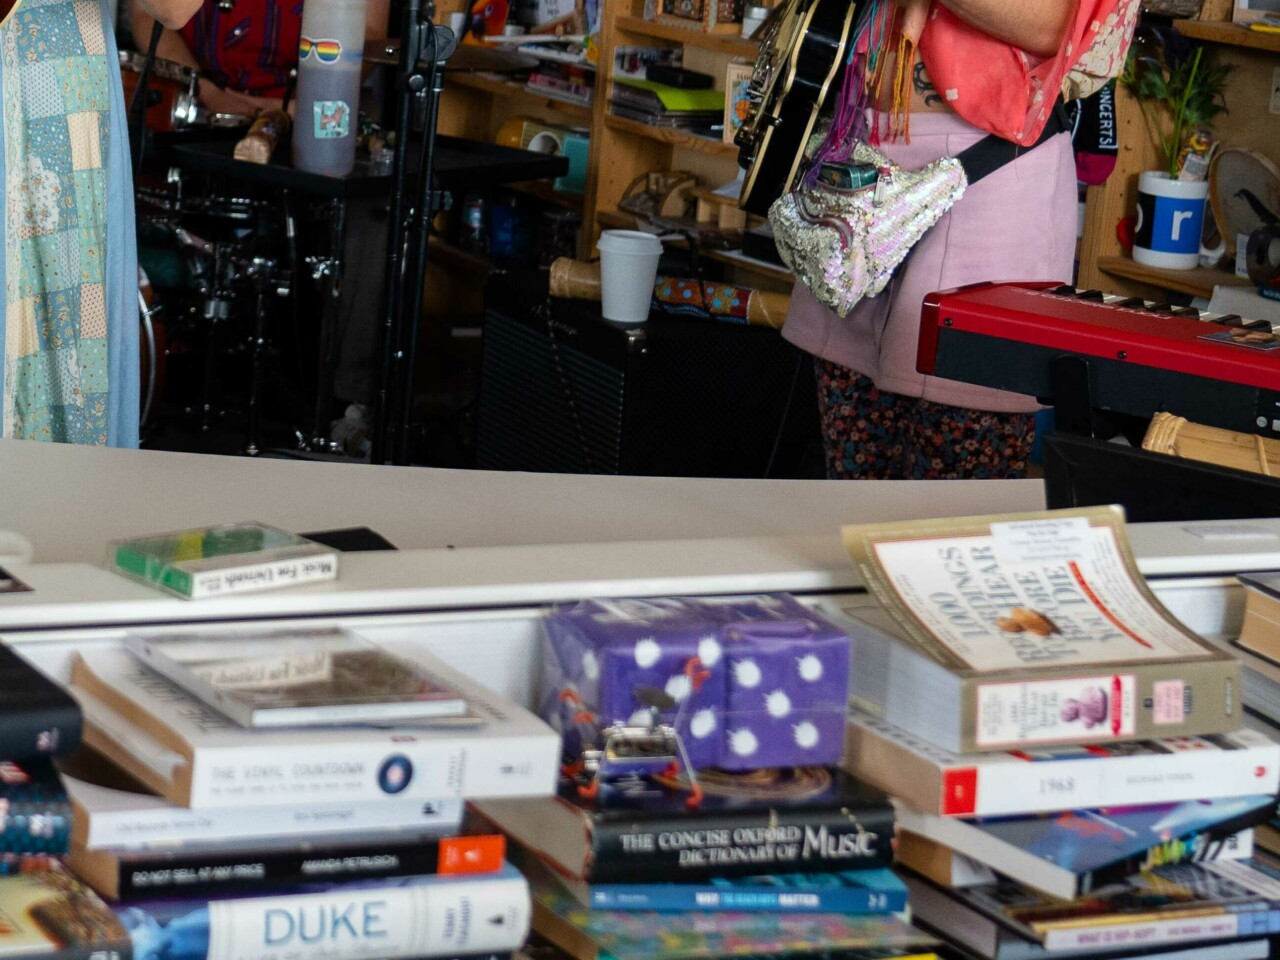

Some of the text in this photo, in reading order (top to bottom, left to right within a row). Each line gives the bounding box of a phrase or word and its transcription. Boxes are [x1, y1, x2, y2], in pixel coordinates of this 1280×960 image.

[969, 545, 1024, 609] HEAR
[1042, 565, 1087, 606] DIE
[210, 766, 236, 781] THE
[292, 761, 366, 778] COUNTDOWN
[1039, 777, 1075, 794] 1968
[621, 825, 802, 852] THE CONCISE OXFORD
[679, 845, 772, 865] DICTIONARY
[774, 843, 801, 860] OF
[131, 855, 398, 885] DO NOT SELL AT ANY PRICE AMANDA PETRUSICH
[263, 900, 387, 946] DUKE
